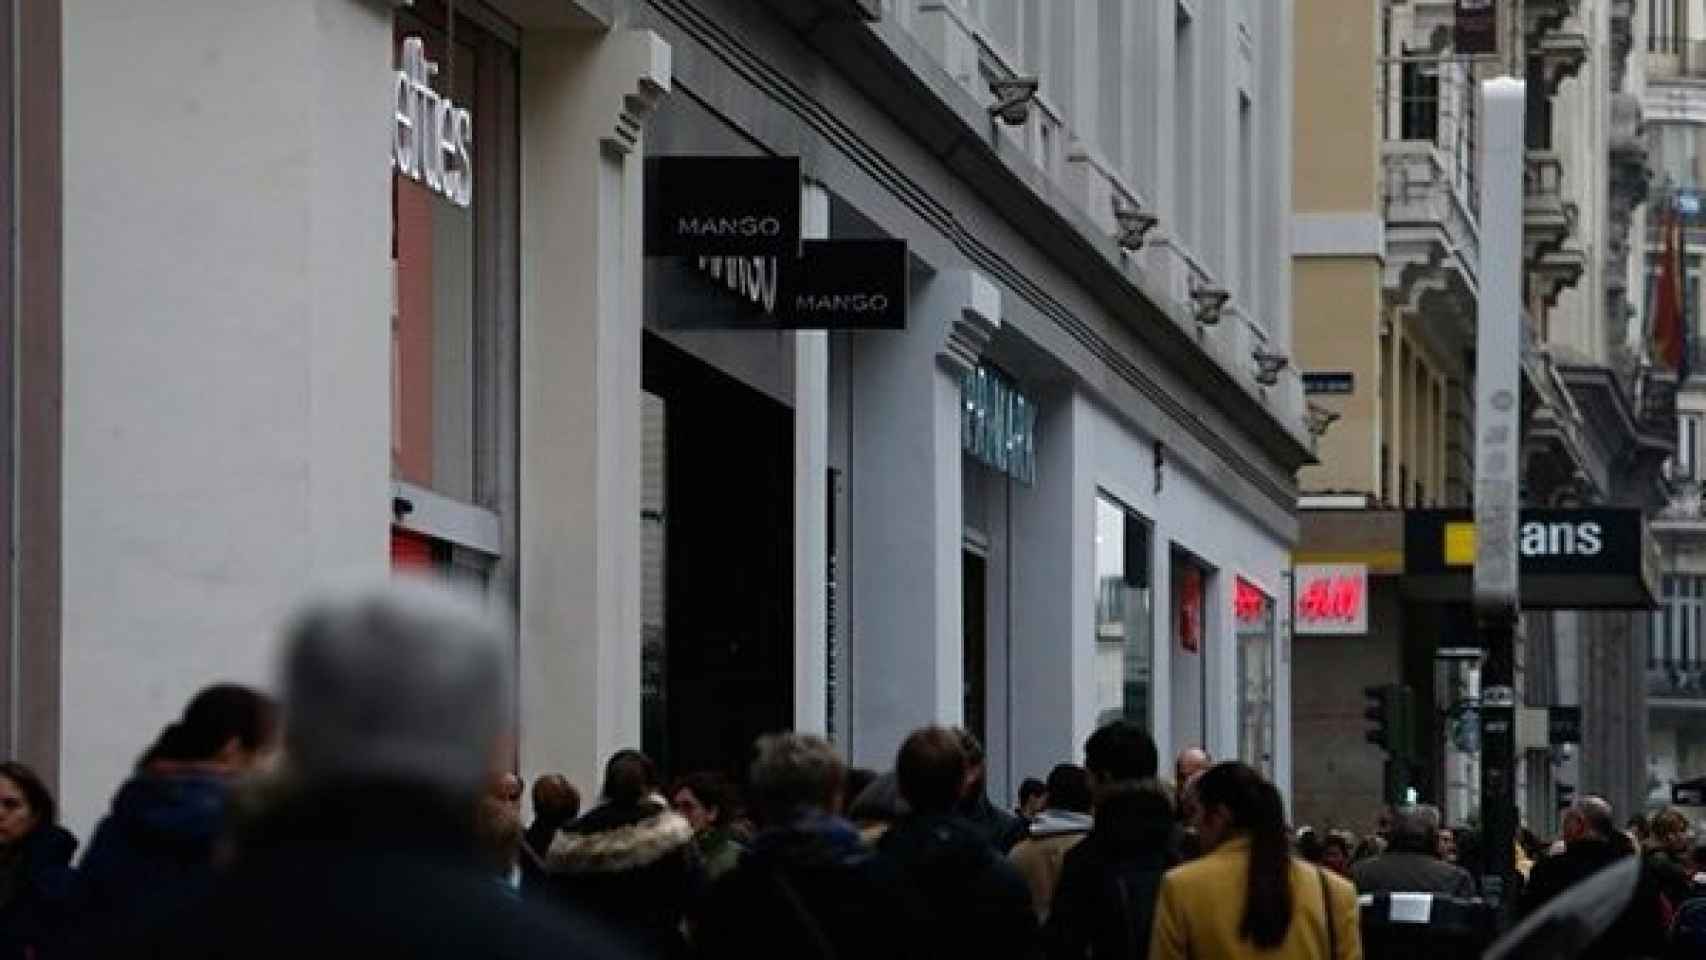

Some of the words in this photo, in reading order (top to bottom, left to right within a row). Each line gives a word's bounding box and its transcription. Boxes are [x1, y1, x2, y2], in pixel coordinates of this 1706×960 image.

[678, 216, 780, 236] MANGO
[796, 294, 888, 312] MANGO
[1520, 521, 1601, 555] ans
